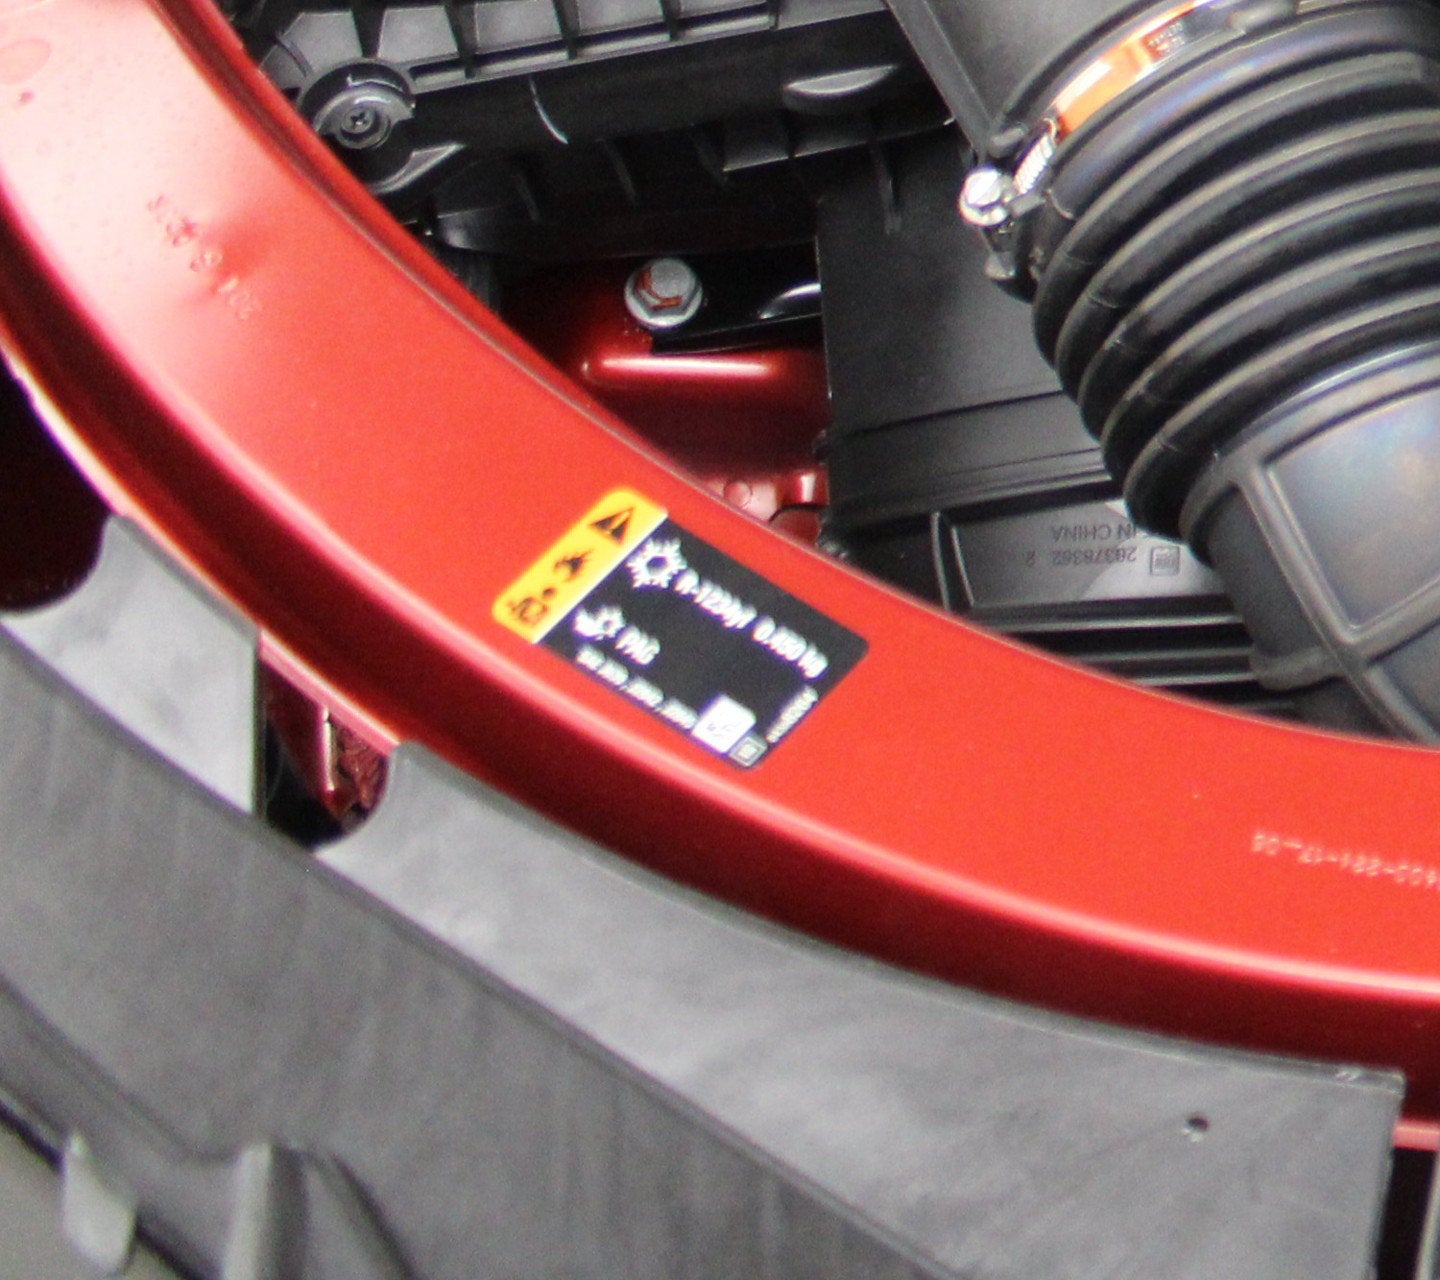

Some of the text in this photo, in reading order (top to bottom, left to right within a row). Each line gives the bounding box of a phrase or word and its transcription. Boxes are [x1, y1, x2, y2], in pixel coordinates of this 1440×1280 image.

[1051, 523, 1112, 543] CHINA
[615, 624, 660, 665] PAG
[799, 649, 830, 681] kg
